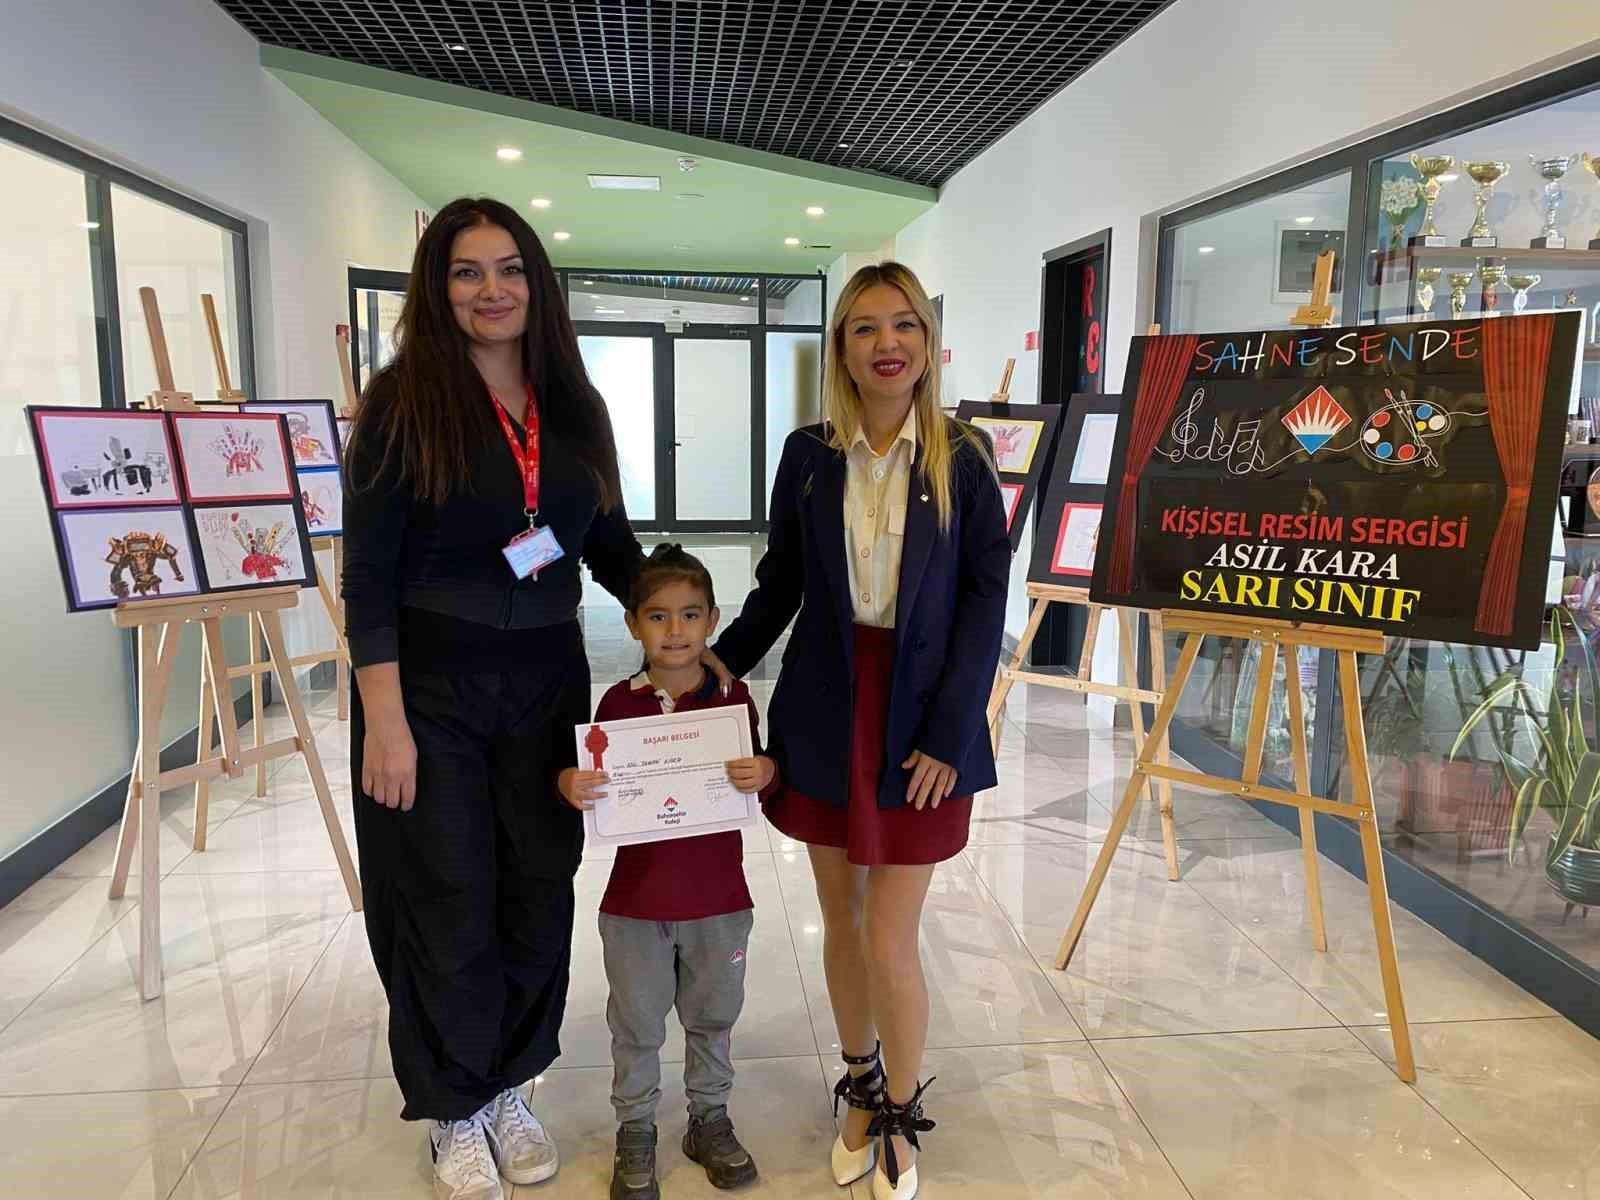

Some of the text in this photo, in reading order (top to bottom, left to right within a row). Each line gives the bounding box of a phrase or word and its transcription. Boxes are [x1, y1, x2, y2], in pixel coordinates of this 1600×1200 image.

[1194, 326, 1481, 374] SAHNE SENDE
[1160, 504, 1469, 549] KİŞİSEL RESİM SERGİSİ
[1204, 538, 1400, 581] ASİL KARA
[1180, 569, 1421, 623] SARI SINIF
